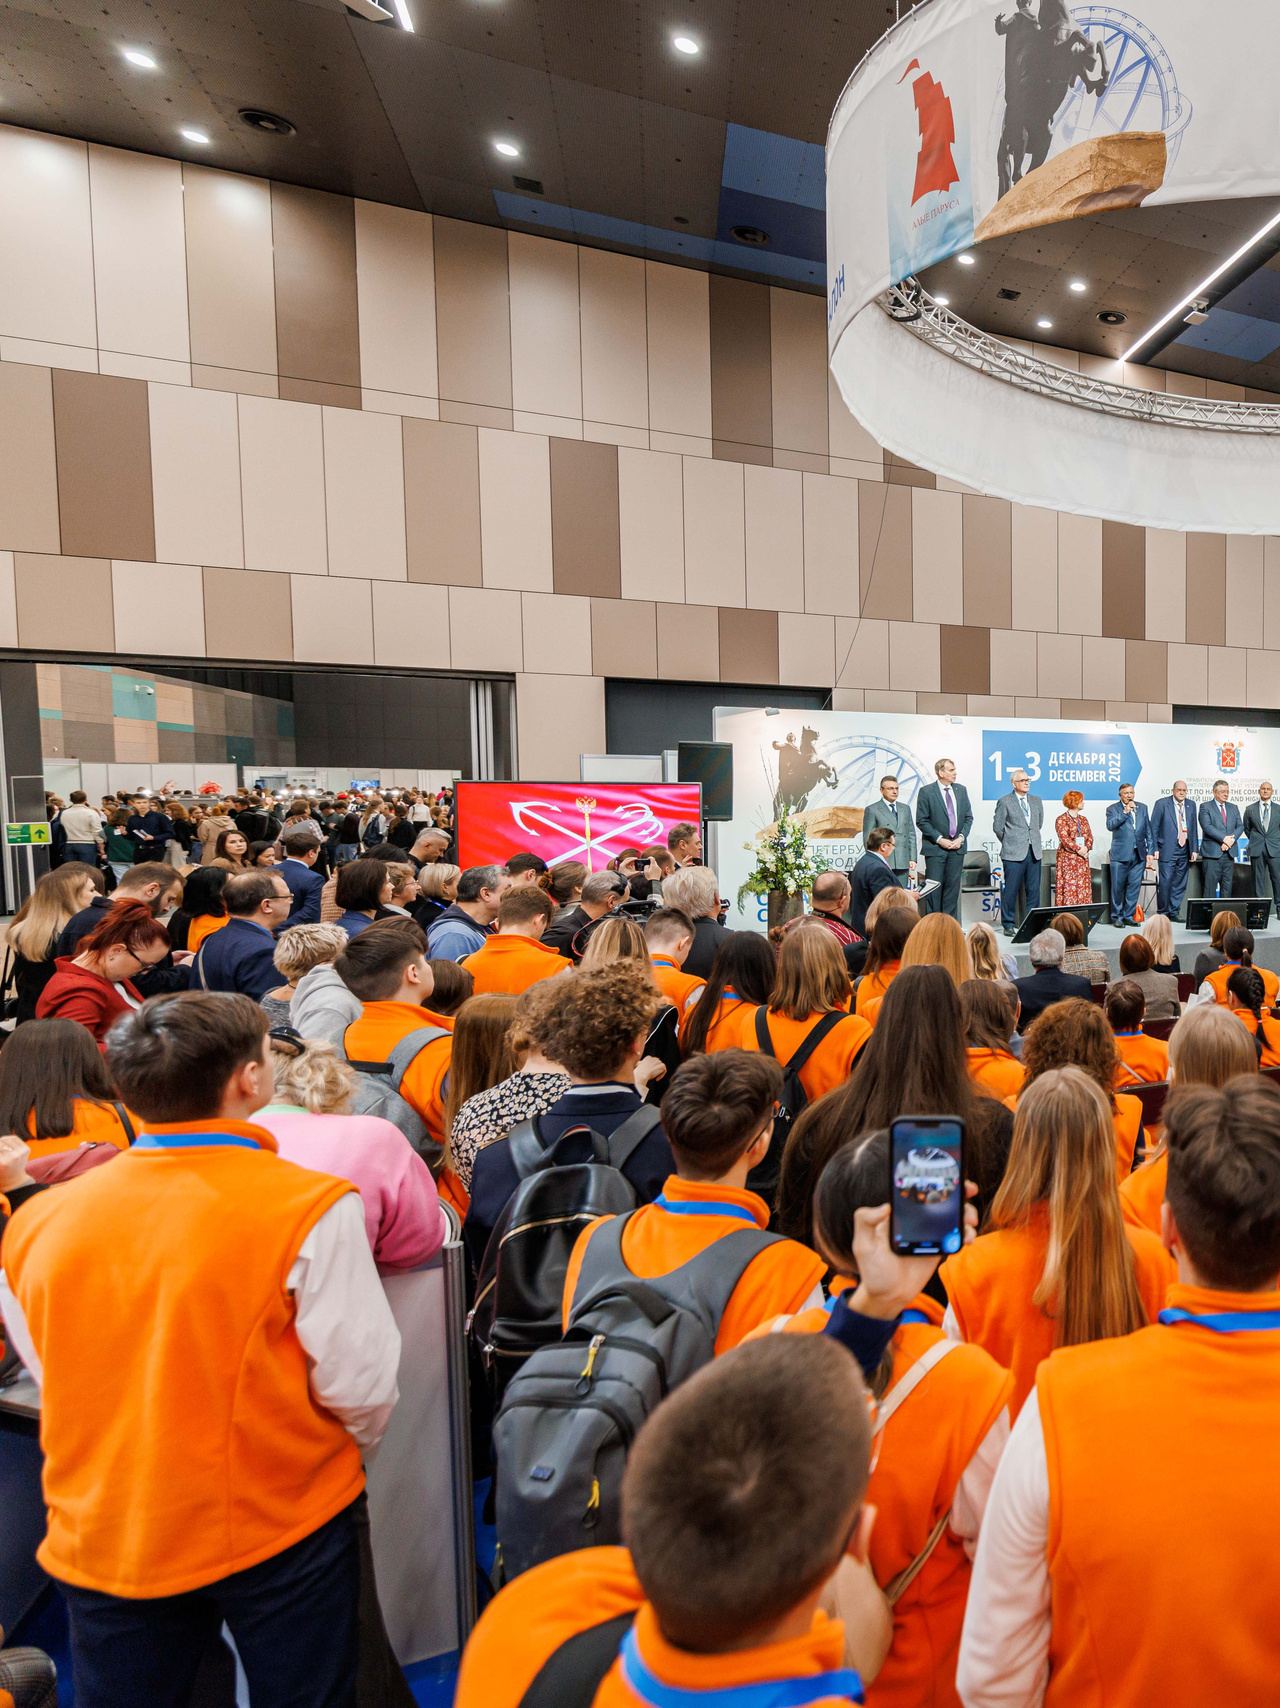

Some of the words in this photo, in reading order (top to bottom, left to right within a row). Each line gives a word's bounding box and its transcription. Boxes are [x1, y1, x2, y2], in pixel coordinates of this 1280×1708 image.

[912, 212, 930, 231] АЛЫЕ
[930, 198, 961, 219] ПАРУСА
[1048, 751, 1106, 767] ДЕКАБРЯ
[1108, 752, 1121, 782] 2022
[1049, 769, 1107, 783] DECEMBER
